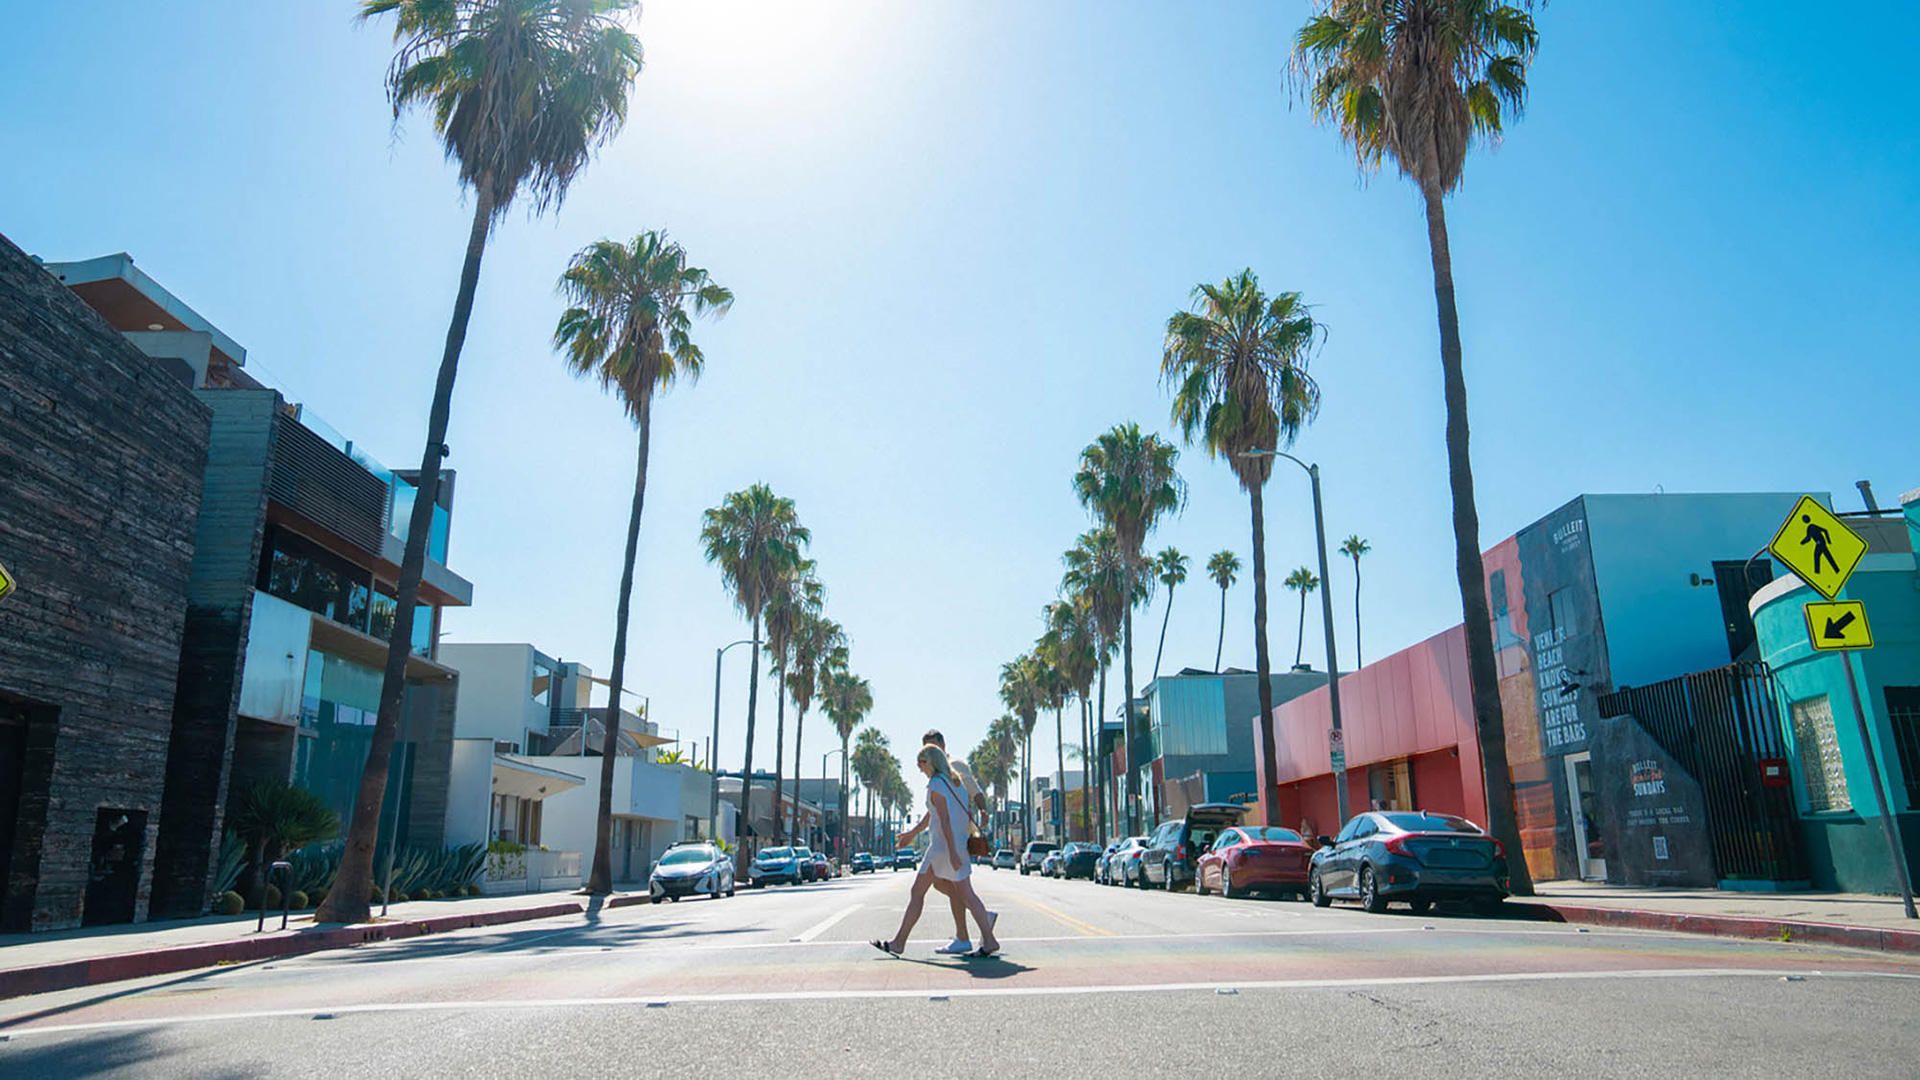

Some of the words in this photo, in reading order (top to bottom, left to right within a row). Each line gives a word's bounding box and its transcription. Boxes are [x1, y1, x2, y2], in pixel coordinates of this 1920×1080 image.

[1553, 519, 1583, 544] BULLEIT
[1537, 646, 1563, 669] BEACH
[1545, 708, 1561, 728] ARE
[1561, 704, 1579, 724] FOR
[1546, 727, 1563, 746] THE
[1563, 722, 1586, 743] BARS
[1633, 780, 1665, 796] SUNDAYS
